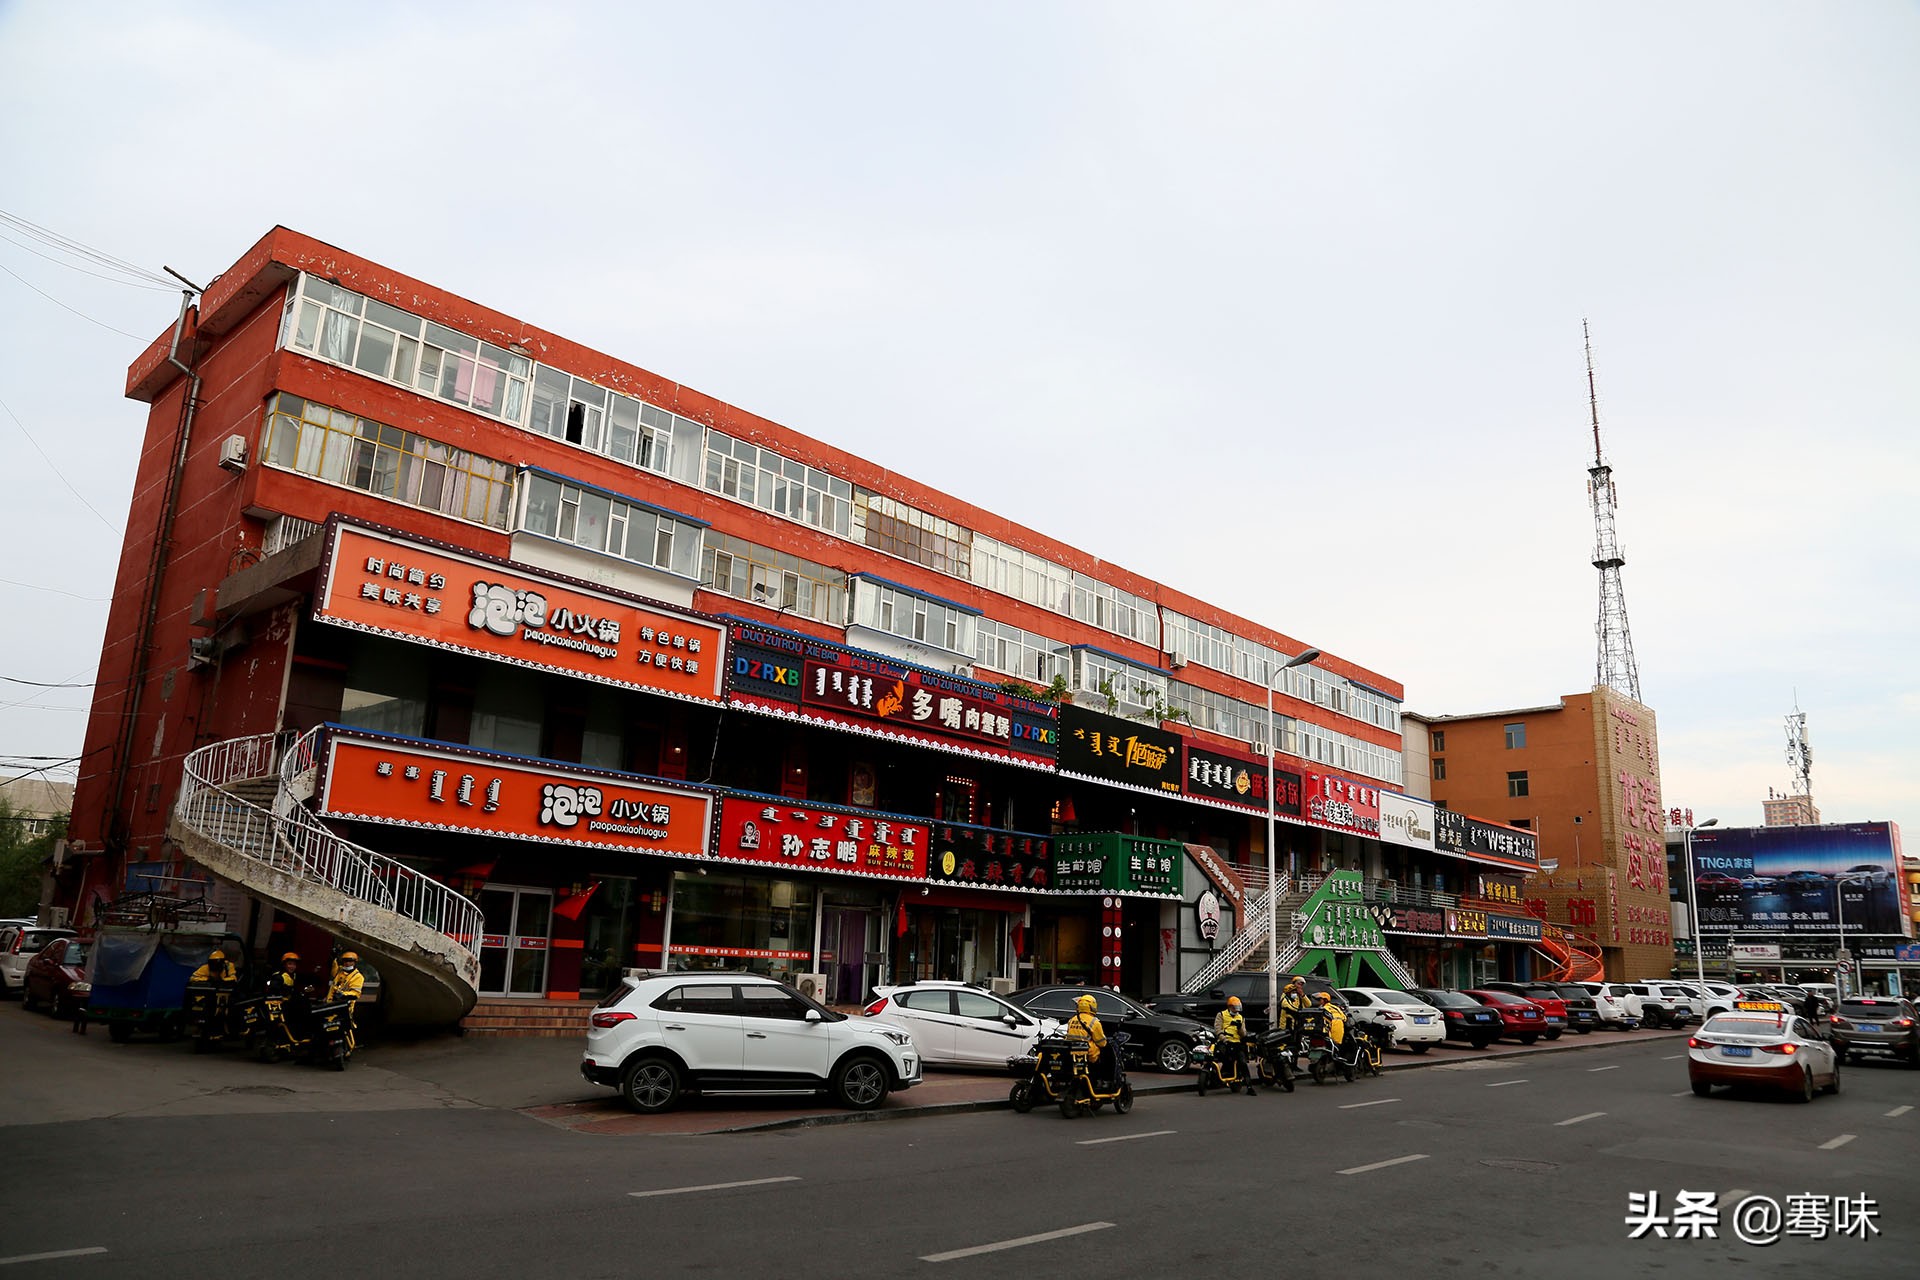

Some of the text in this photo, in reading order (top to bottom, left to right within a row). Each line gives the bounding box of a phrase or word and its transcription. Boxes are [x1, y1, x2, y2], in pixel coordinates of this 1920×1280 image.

[367, 556, 446, 590] 时尚简约
[362, 582, 442, 614] 美味共享
[523, 627, 619, 659] paopaoxiaohuoguo
[640, 625, 702, 654] 特色单锅
[742, 628, 764, 643] DUO
[765, 634, 781, 647] ZUI
[805, 645, 820, 657] XIE
[821, 649, 840, 662] BAO
[638, 648, 700, 676] 方便快捷
[735, 656, 800, 687] DZRXB
[921, 674, 939, 687] DUO
[982, 690, 998, 701] BAO
[912, 688, 1010, 740] 多嘴肉蟹煲
[1013, 722, 1057, 745] DZRXB
[539, 783, 671, 827] 泡泡小火锅
[588, 818, 669, 841] paopaoxiaohuoguo
[782, 833, 858, 864] 孙志鹏
[867, 843, 915, 863] 麻辣烫
[1327, 925, 1379, 947] 兰州牛肉面
